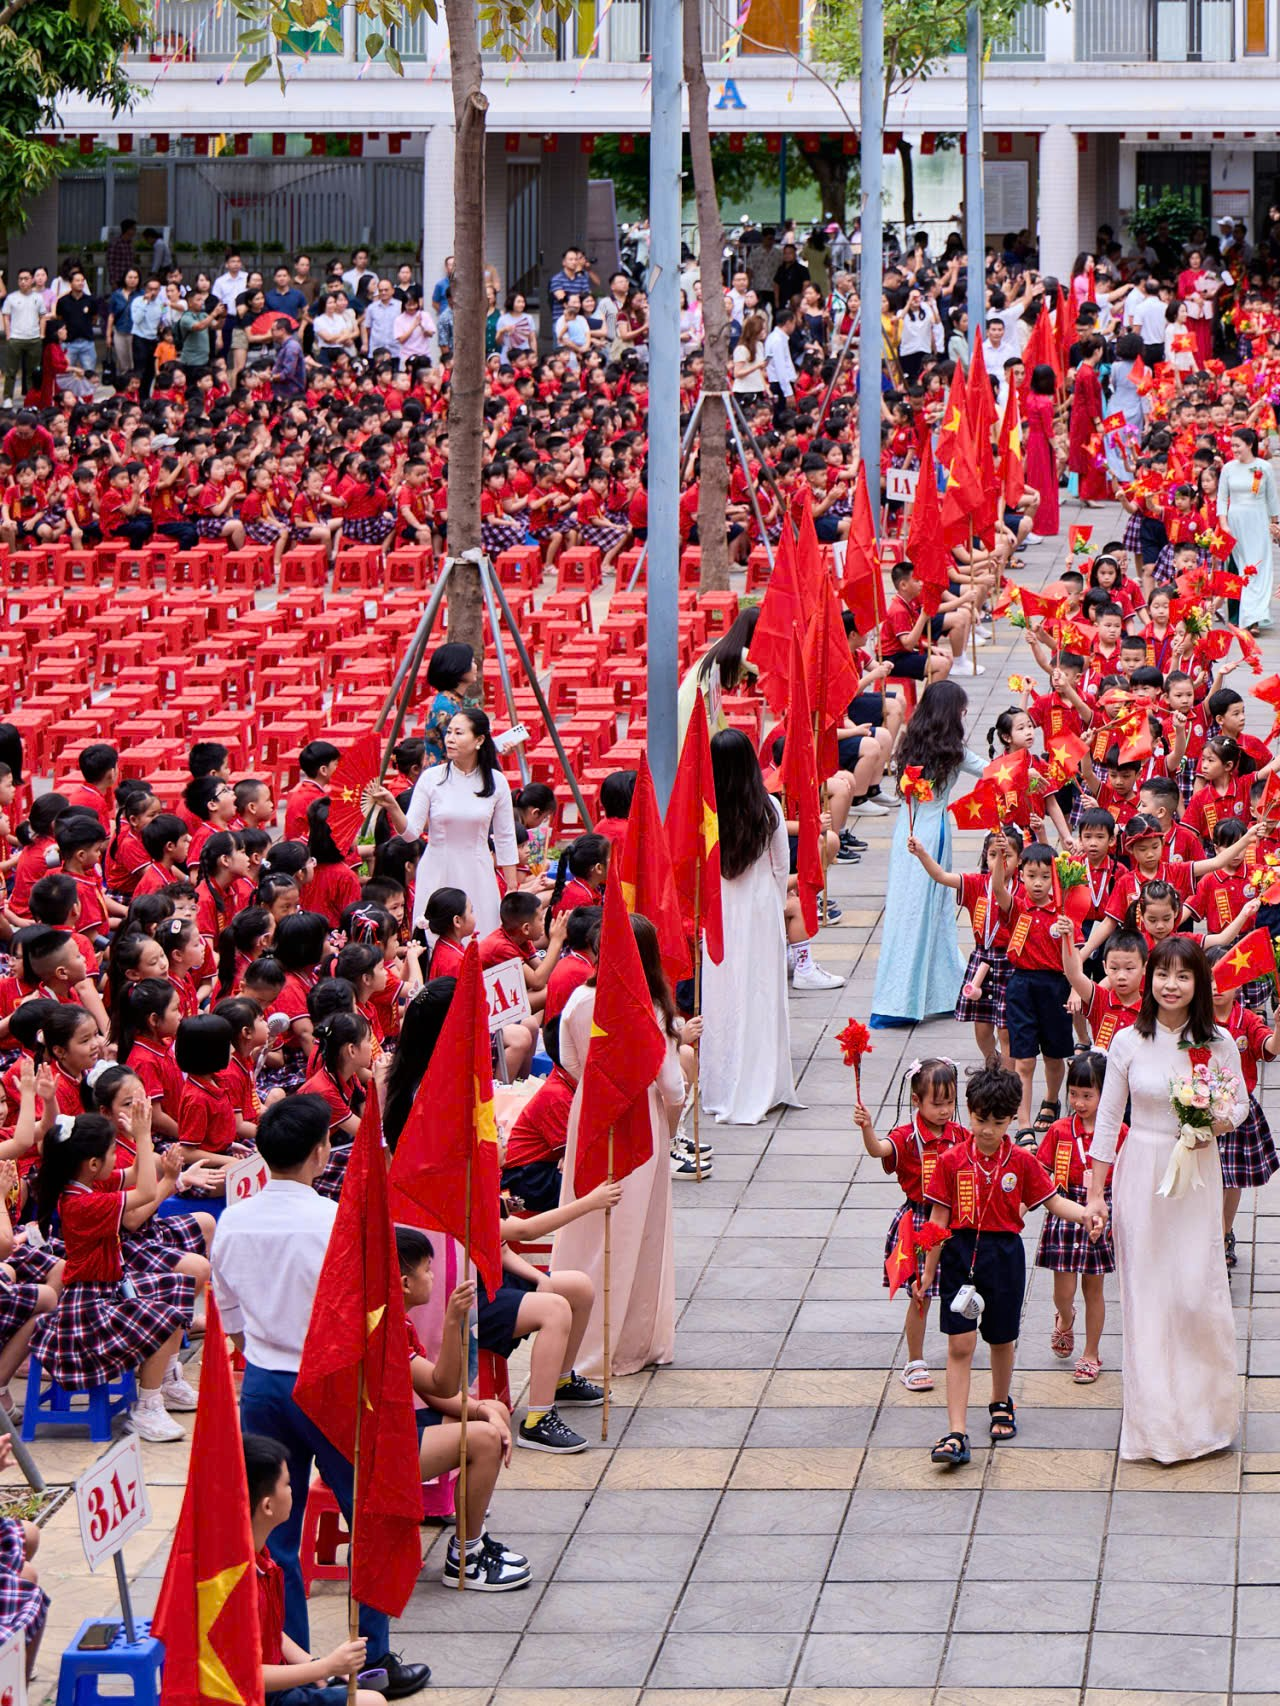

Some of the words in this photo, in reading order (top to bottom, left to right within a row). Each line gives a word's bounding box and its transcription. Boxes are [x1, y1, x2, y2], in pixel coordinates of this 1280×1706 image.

[714, 78, 747, 110] A
[487, 978, 520, 1016] A4
[88, 1469, 137, 1542] 3A7
